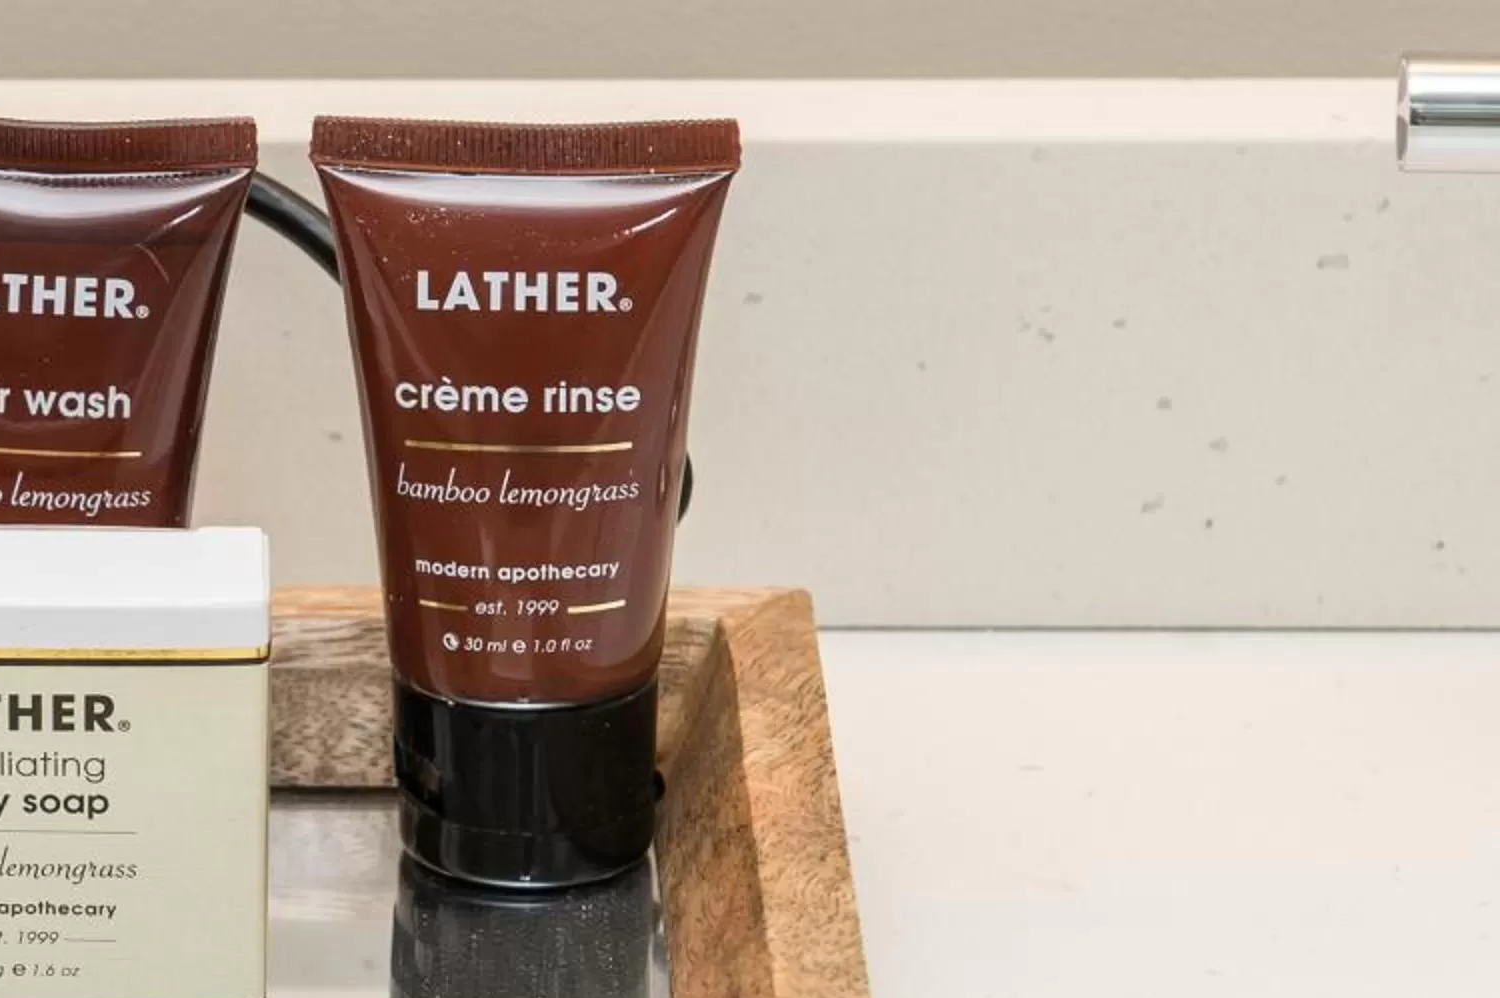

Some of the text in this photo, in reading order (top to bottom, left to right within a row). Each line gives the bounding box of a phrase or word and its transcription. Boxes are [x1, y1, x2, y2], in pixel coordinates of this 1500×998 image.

[23, 385, 132, 419] wash
[394, 376, 642, 414] crème rinse
[10, 471, 153, 517] lemongrass
[396, 463, 640, 511] bamboo lemongrass
[415, 558, 620, 583] modern apothecary
[474, 599, 560, 616] est. 1999
[463, 636, 483, 651] 30
[487, 638, 508, 652] ml
[533, 638, 557, 653] 1.0
[560, 637, 571, 651] fl
[574, 637, 593, 650] oz
[21, 790, 110, 819] soap
[17, 930, 60, 945] 1999
[32, 963, 56, 977] 1.6
[61, 966, 81, 977] oz
